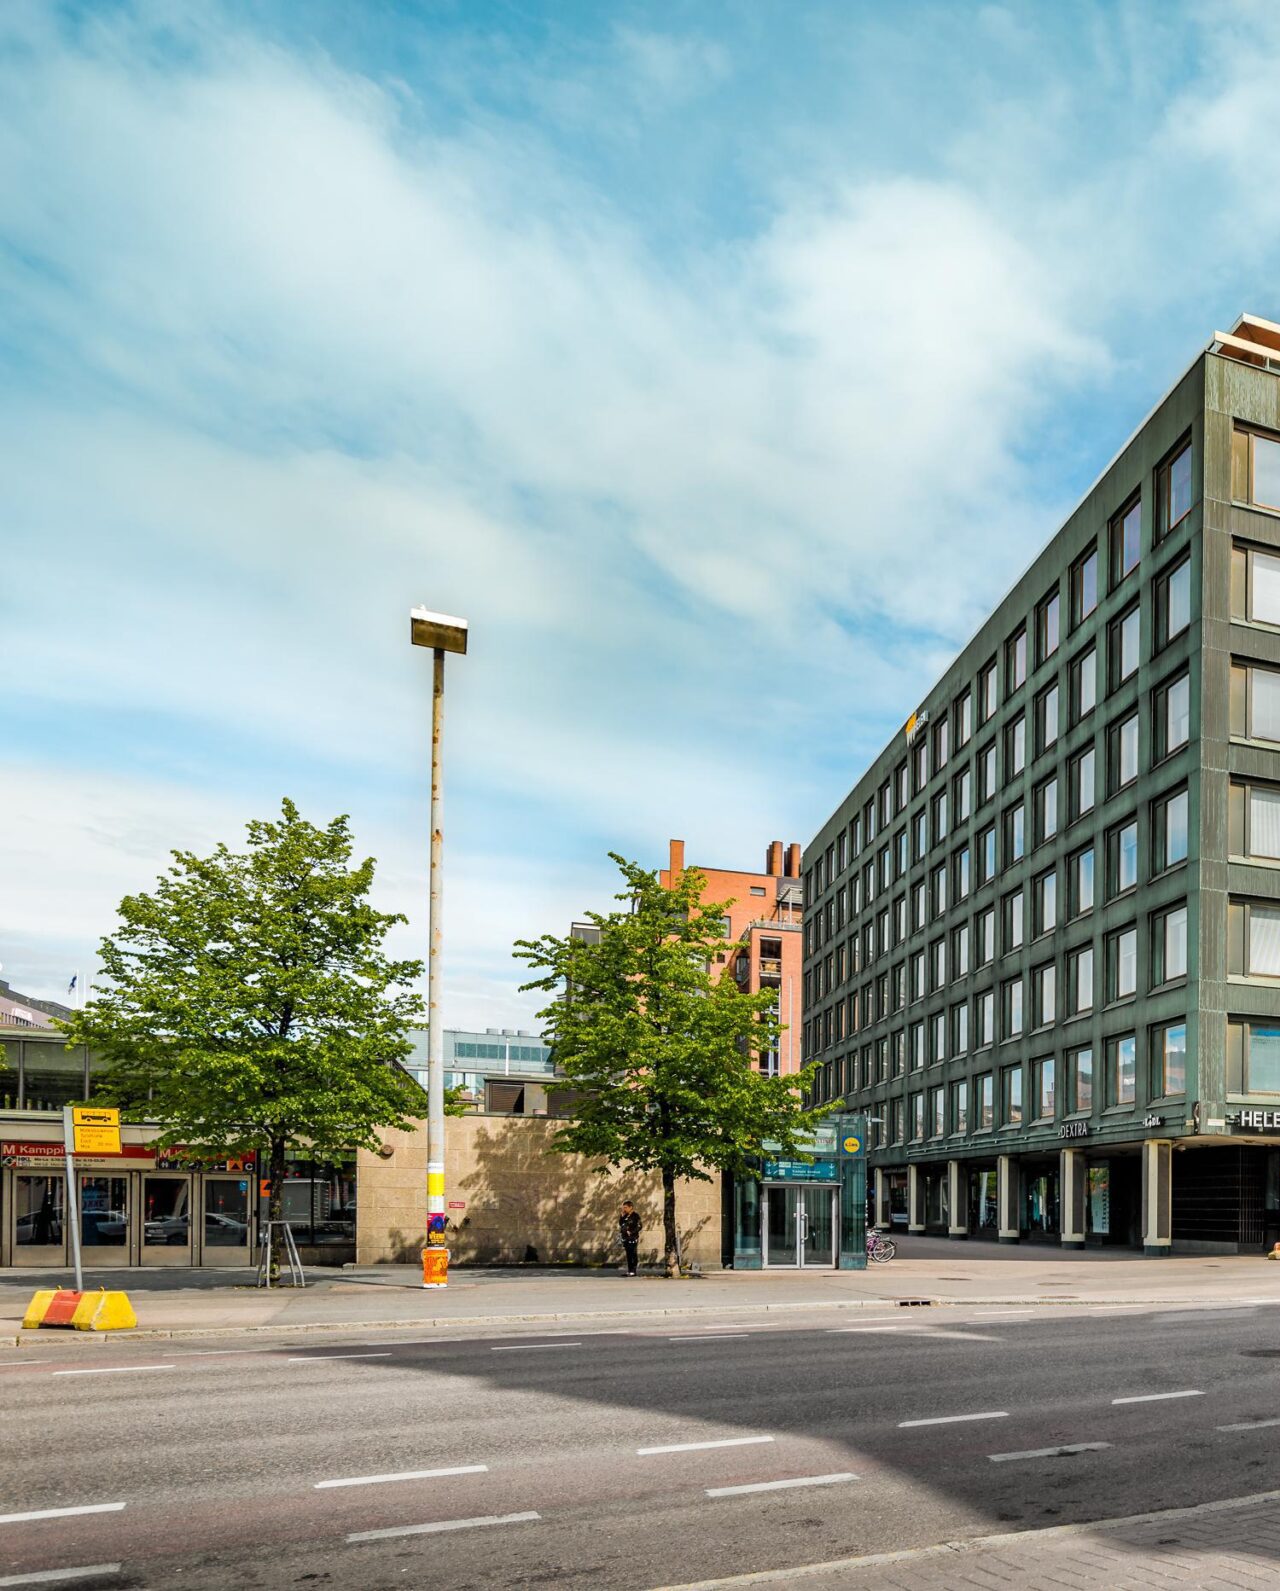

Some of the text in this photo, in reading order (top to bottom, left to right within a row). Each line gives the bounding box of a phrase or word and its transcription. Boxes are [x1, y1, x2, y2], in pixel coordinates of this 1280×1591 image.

[1060, 1122, 1088, 1138] DEXTRA
[3, 1145, 65, 1155] M Kamppi
